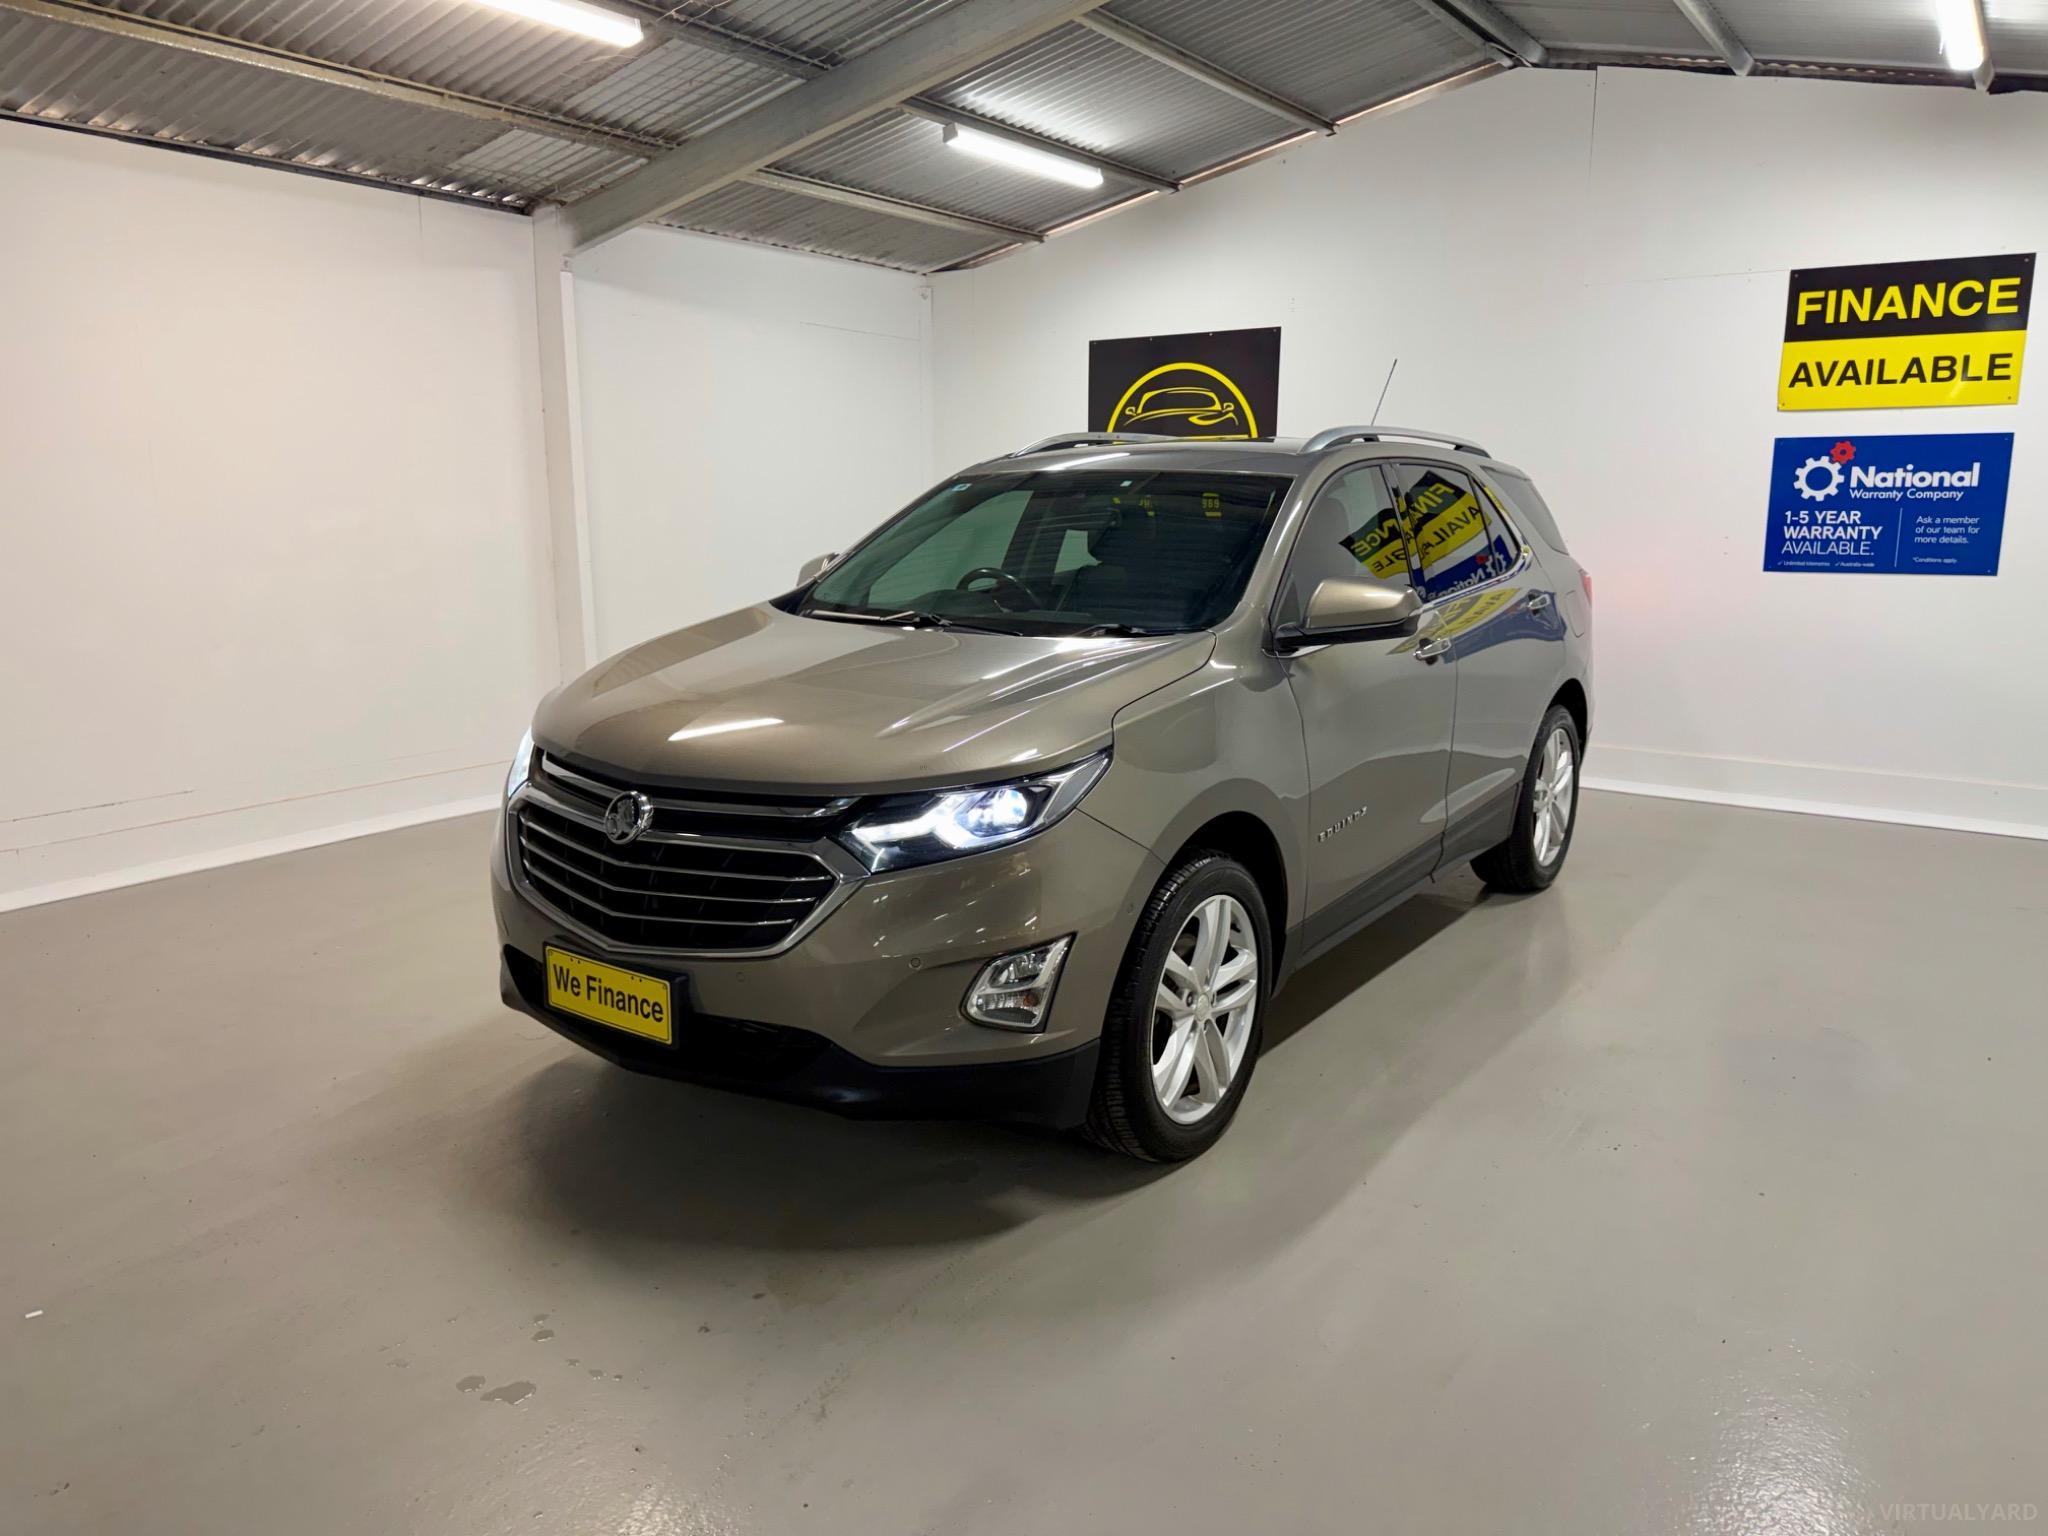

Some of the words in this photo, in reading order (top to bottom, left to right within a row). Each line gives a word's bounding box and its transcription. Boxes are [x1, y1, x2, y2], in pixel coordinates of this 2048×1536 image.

[1796, 277, 2021, 325] FINANCE
[1788, 353, 2013, 388] AVAILABLE
[1850, 462, 1980, 488] National
[1849, 488, 1903, 501] Warranty
[1906, 488, 1964, 501] Company
[1785, 510, 1809, 524] 1-5
[1815, 510, 1861, 524] YEAR
[1916, 516, 1933, 524] Ask
[1942, 515, 1980, 524] member
[1783, 526, 1883, 540] WARRANTY
[1915, 525, 1925, 534] of
[1926, 526, 1941, 534] our
[1943, 526, 1966, 534] team
[1967, 525, 1980, 534] for
[1914, 536, 1937, 544] more
[1781, 541, 1874, 556] AVAILABLE.
[553, 964, 581, 997] We
[586, 975, 664, 1023] Finance
